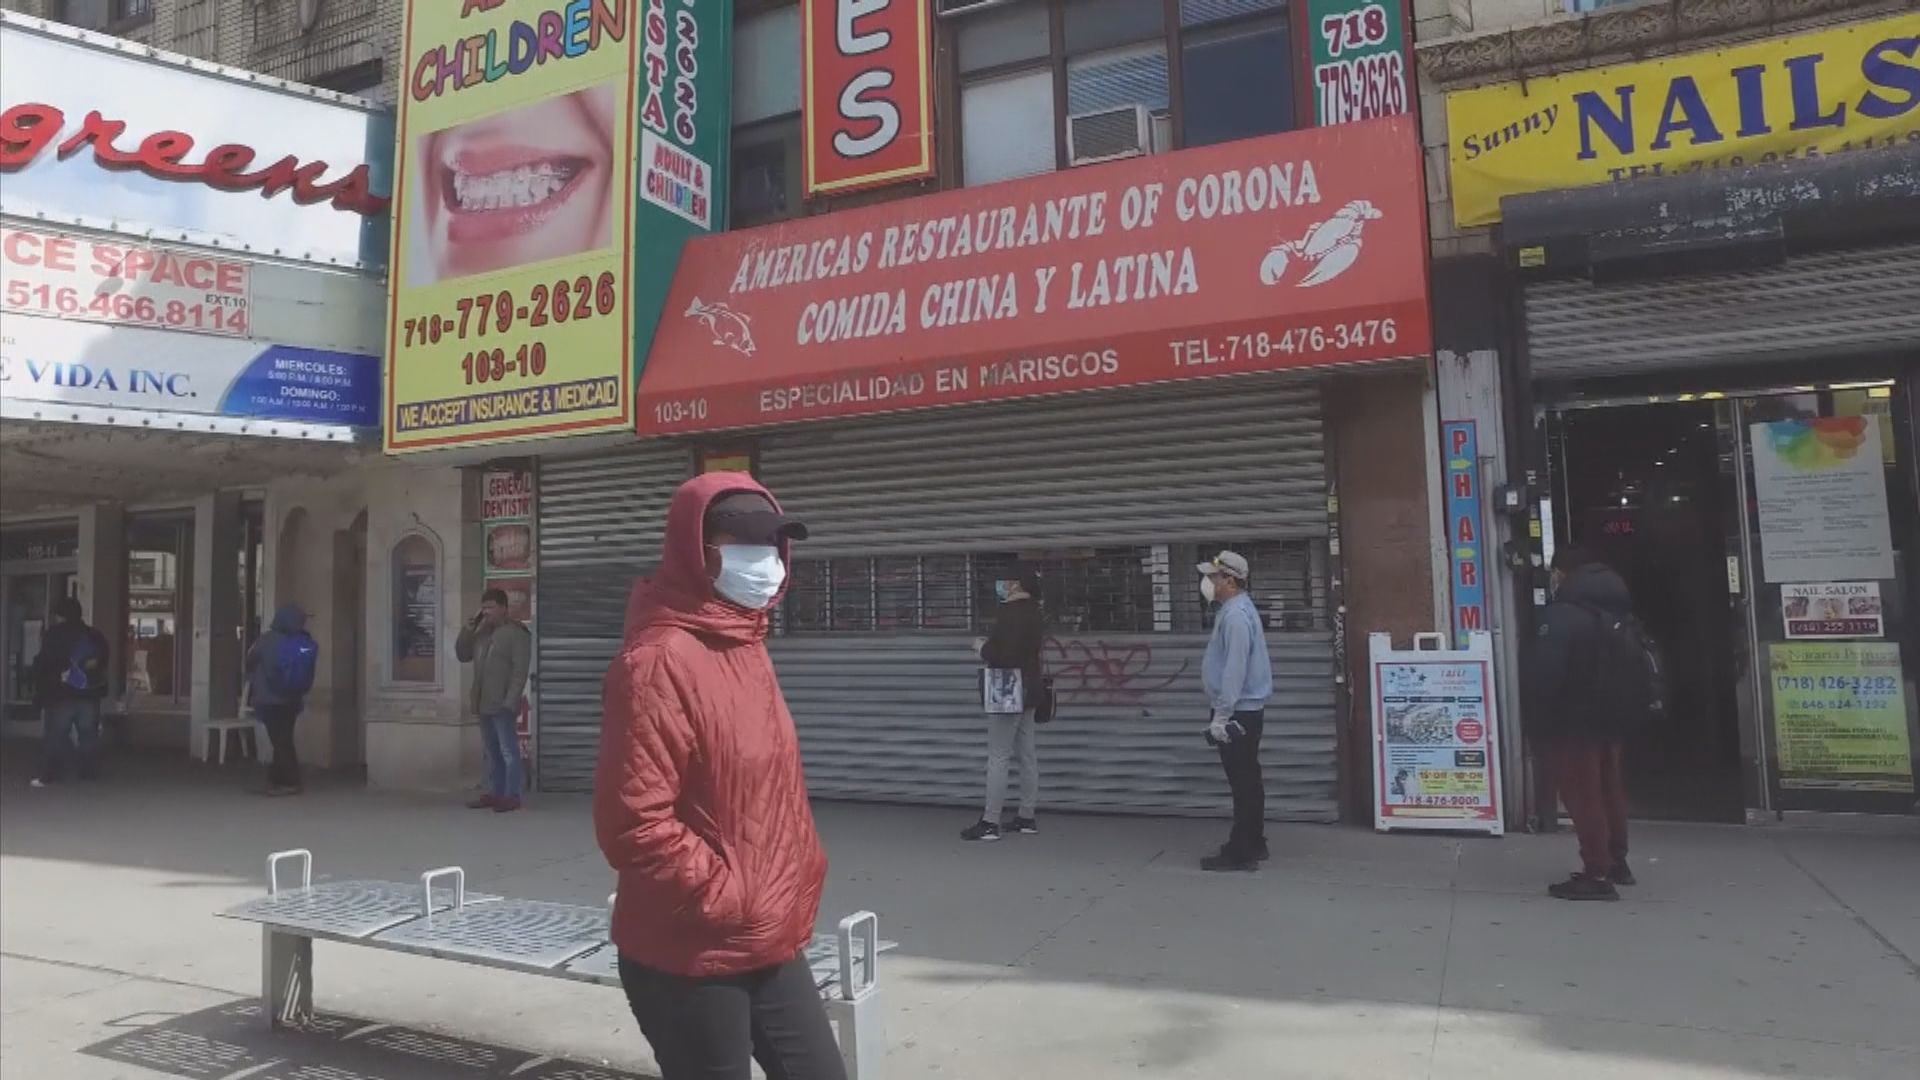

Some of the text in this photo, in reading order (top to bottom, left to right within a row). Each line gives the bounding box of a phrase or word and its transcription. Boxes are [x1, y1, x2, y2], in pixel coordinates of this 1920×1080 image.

[412, 0, 626, 101] CHILDREN
[1322, 6, 1386, 56] 718
[1317, 53, 1405, 126] 779-2626
[1571, 37, 1920, 160] NAILS
[1463, 103, 1559, 160] Sunny
[655, 142, 692, 184] ADULT
[647, 168, 706, 221] CHILDREN
[729, 160, 1321, 294] AMERICAS RESTAURANTE OF CORONA
[90, 244, 244, 294] SPACE
[7, 280, 247, 333] 516.466.8114
[404, 271, 616, 348] 718-779-2626
[796, 247, 1200, 346] COMIDA CHINA Y LATINA
[26, 358, 120, 393] VIDA
[128, 373, 197, 398] INC.
[461, 342, 547, 385] 103-10
[760, 318, 1397, 413] ESPECIALIDAD EN MARISCOS TEL:718-476-3476
[400, 379, 617, 428] WE ACCEPT INSURANCE & MEDICAID
[654, 398, 707, 424] 103-10
[1792, 585, 1867, 596] NAIL SALON
[1777, 676, 1815, 691] (718)
